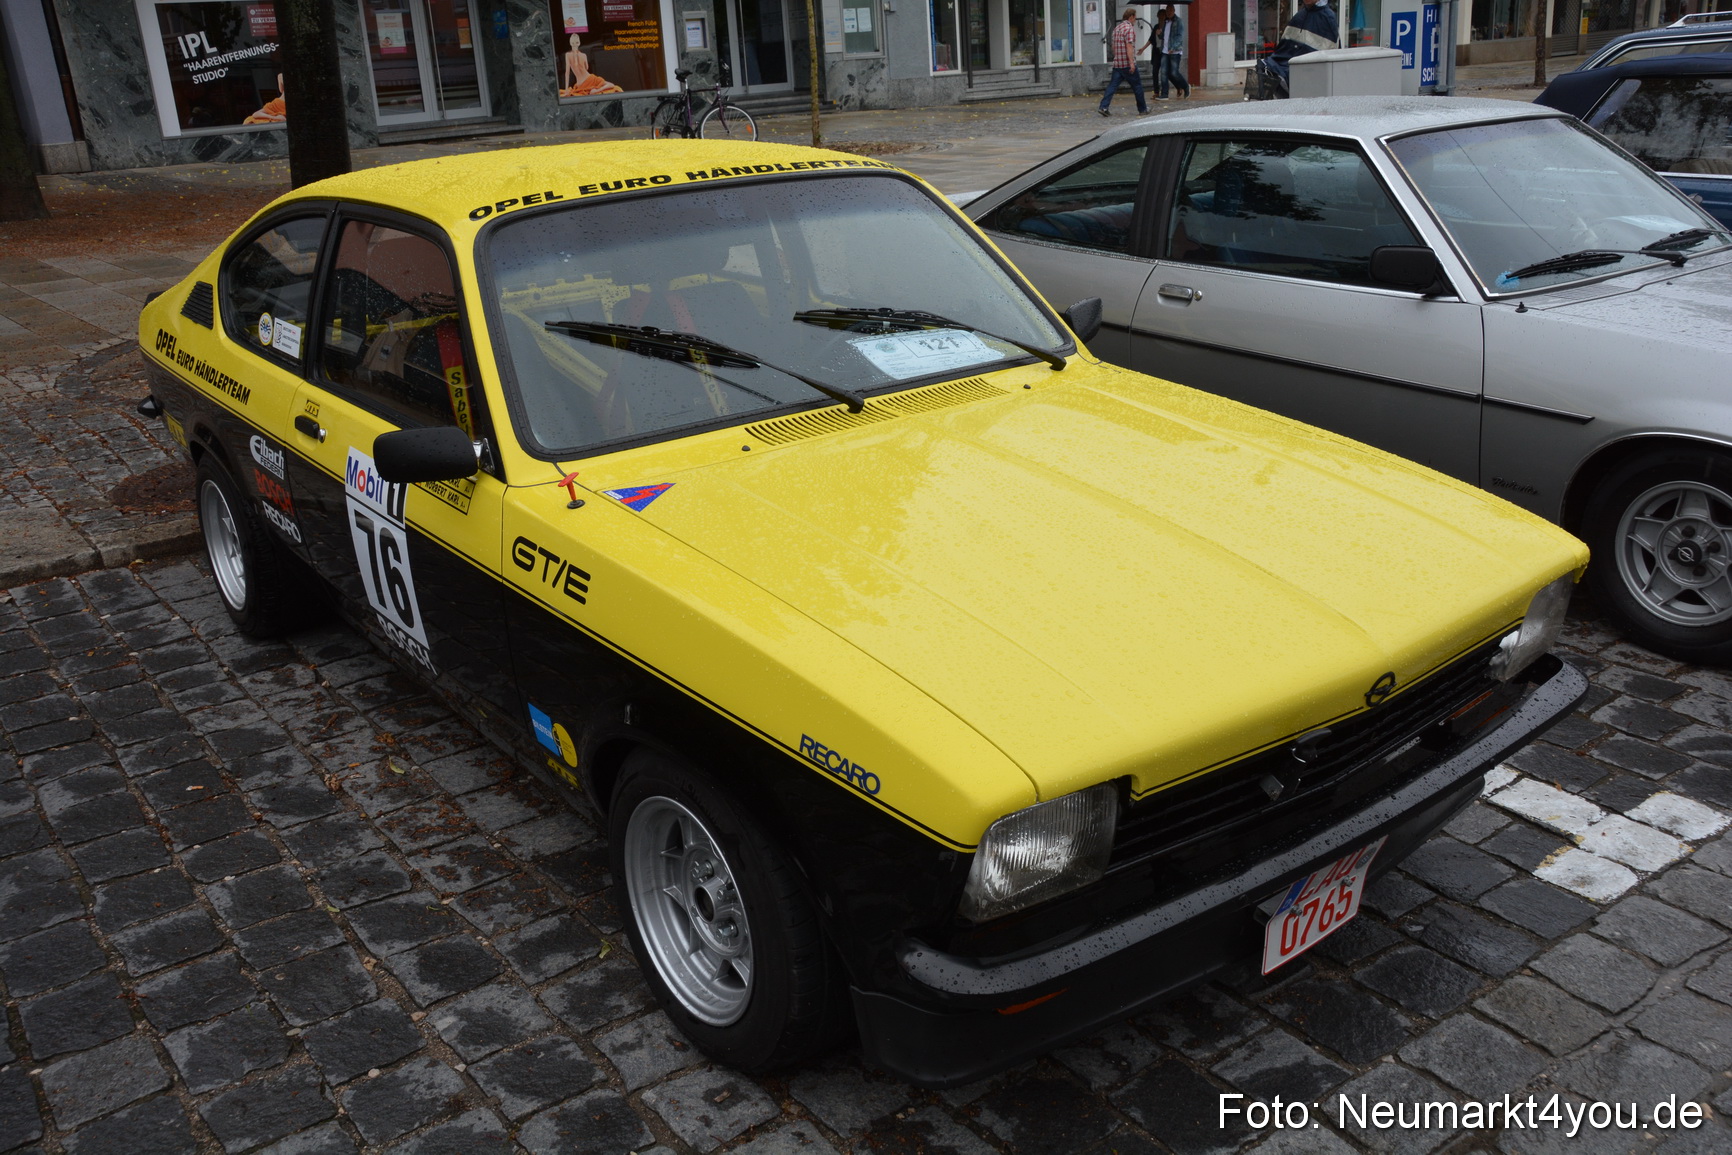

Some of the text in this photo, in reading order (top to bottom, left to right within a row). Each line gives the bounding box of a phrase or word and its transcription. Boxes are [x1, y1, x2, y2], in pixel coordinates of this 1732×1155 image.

[177, 30, 218, 60] IPL
[1396, 20, 1411, 46] P
[469, 190, 565, 222] OPEL
[578, 174, 672, 196] EURO
[155, 328, 251, 406] OPEL EURO HÄNDLERTEAM
[918, 335, 961, 351] 121
[250, 434, 285, 471] Eibach
[254, 468, 295, 517] BOSCH
[346, 455, 384, 505] Mobil
[262, 500, 302, 544] RECARO
[353, 508, 415, 629] 76
[512, 536, 591, 606] GT/E
[376, 612, 438, 676] BOSCH
[799, 733, 881, 795] RECARO
[1280, 875, 1357, 957] 0765
